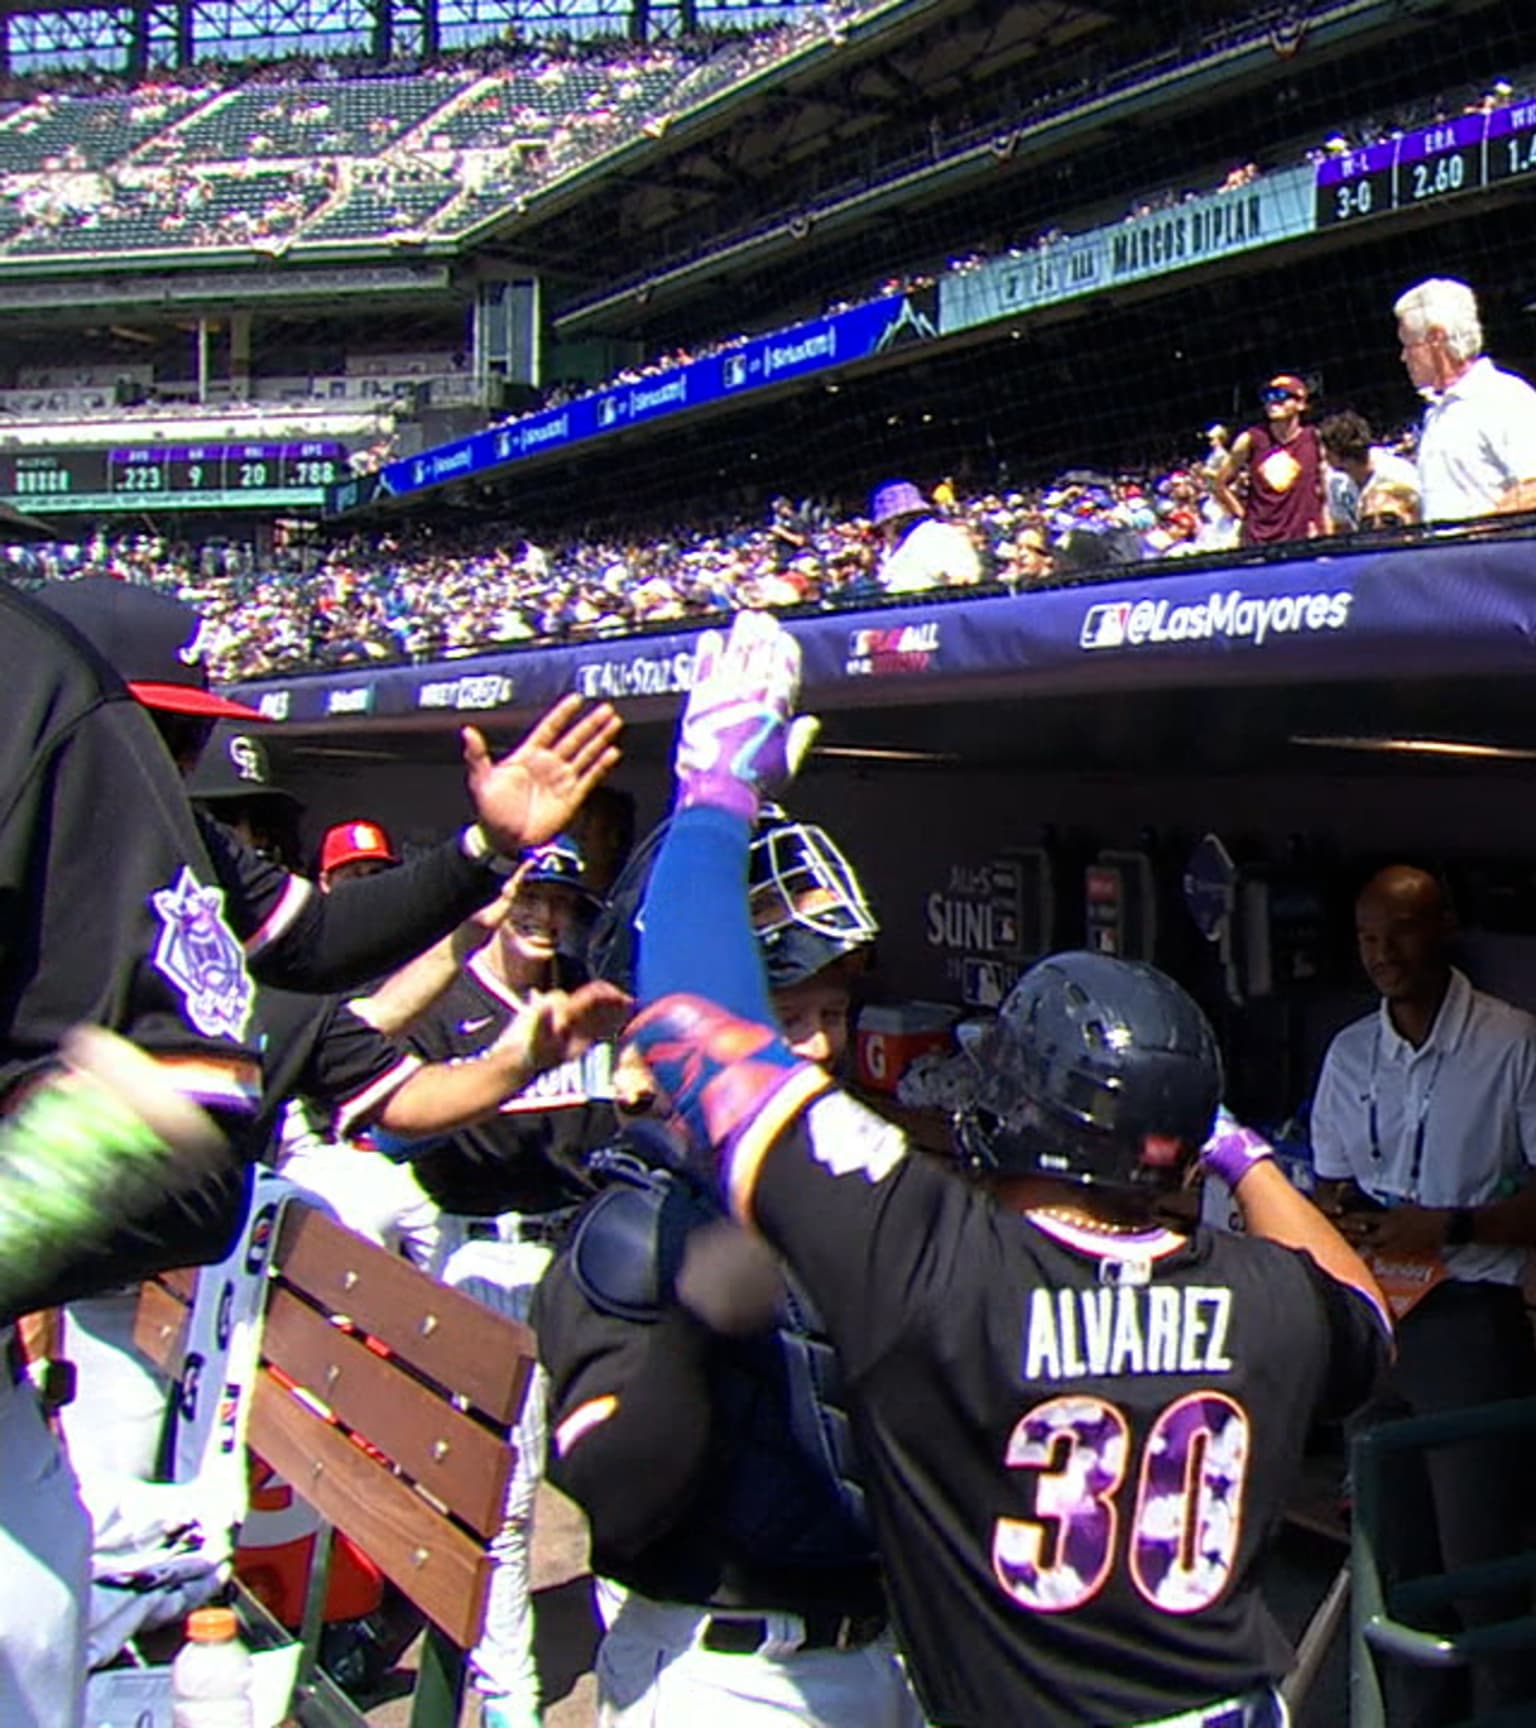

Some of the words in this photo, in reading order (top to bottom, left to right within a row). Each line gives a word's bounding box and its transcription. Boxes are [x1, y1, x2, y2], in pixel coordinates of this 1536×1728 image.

[1425, 128, 1455, 153] ERA
[1336, 181, 1372, 218] 3-0
[1413, 155, 1464, 198] 2.60
[1113, 217, 1186, 275] MARCOS
[116, 467, 161, 491] .223
[189, 466, 203, 488] 9
[241, 463, 266, 487] 20
[289, 461, 336, 487] .788
[1127, 590, 1354, 645] @LasMayores
[948, 864, 994, 895] ALL-S
[1024, 1285, 1233, 1380] ALVAREZ
[991, 1389, 1251, 1613] 30
